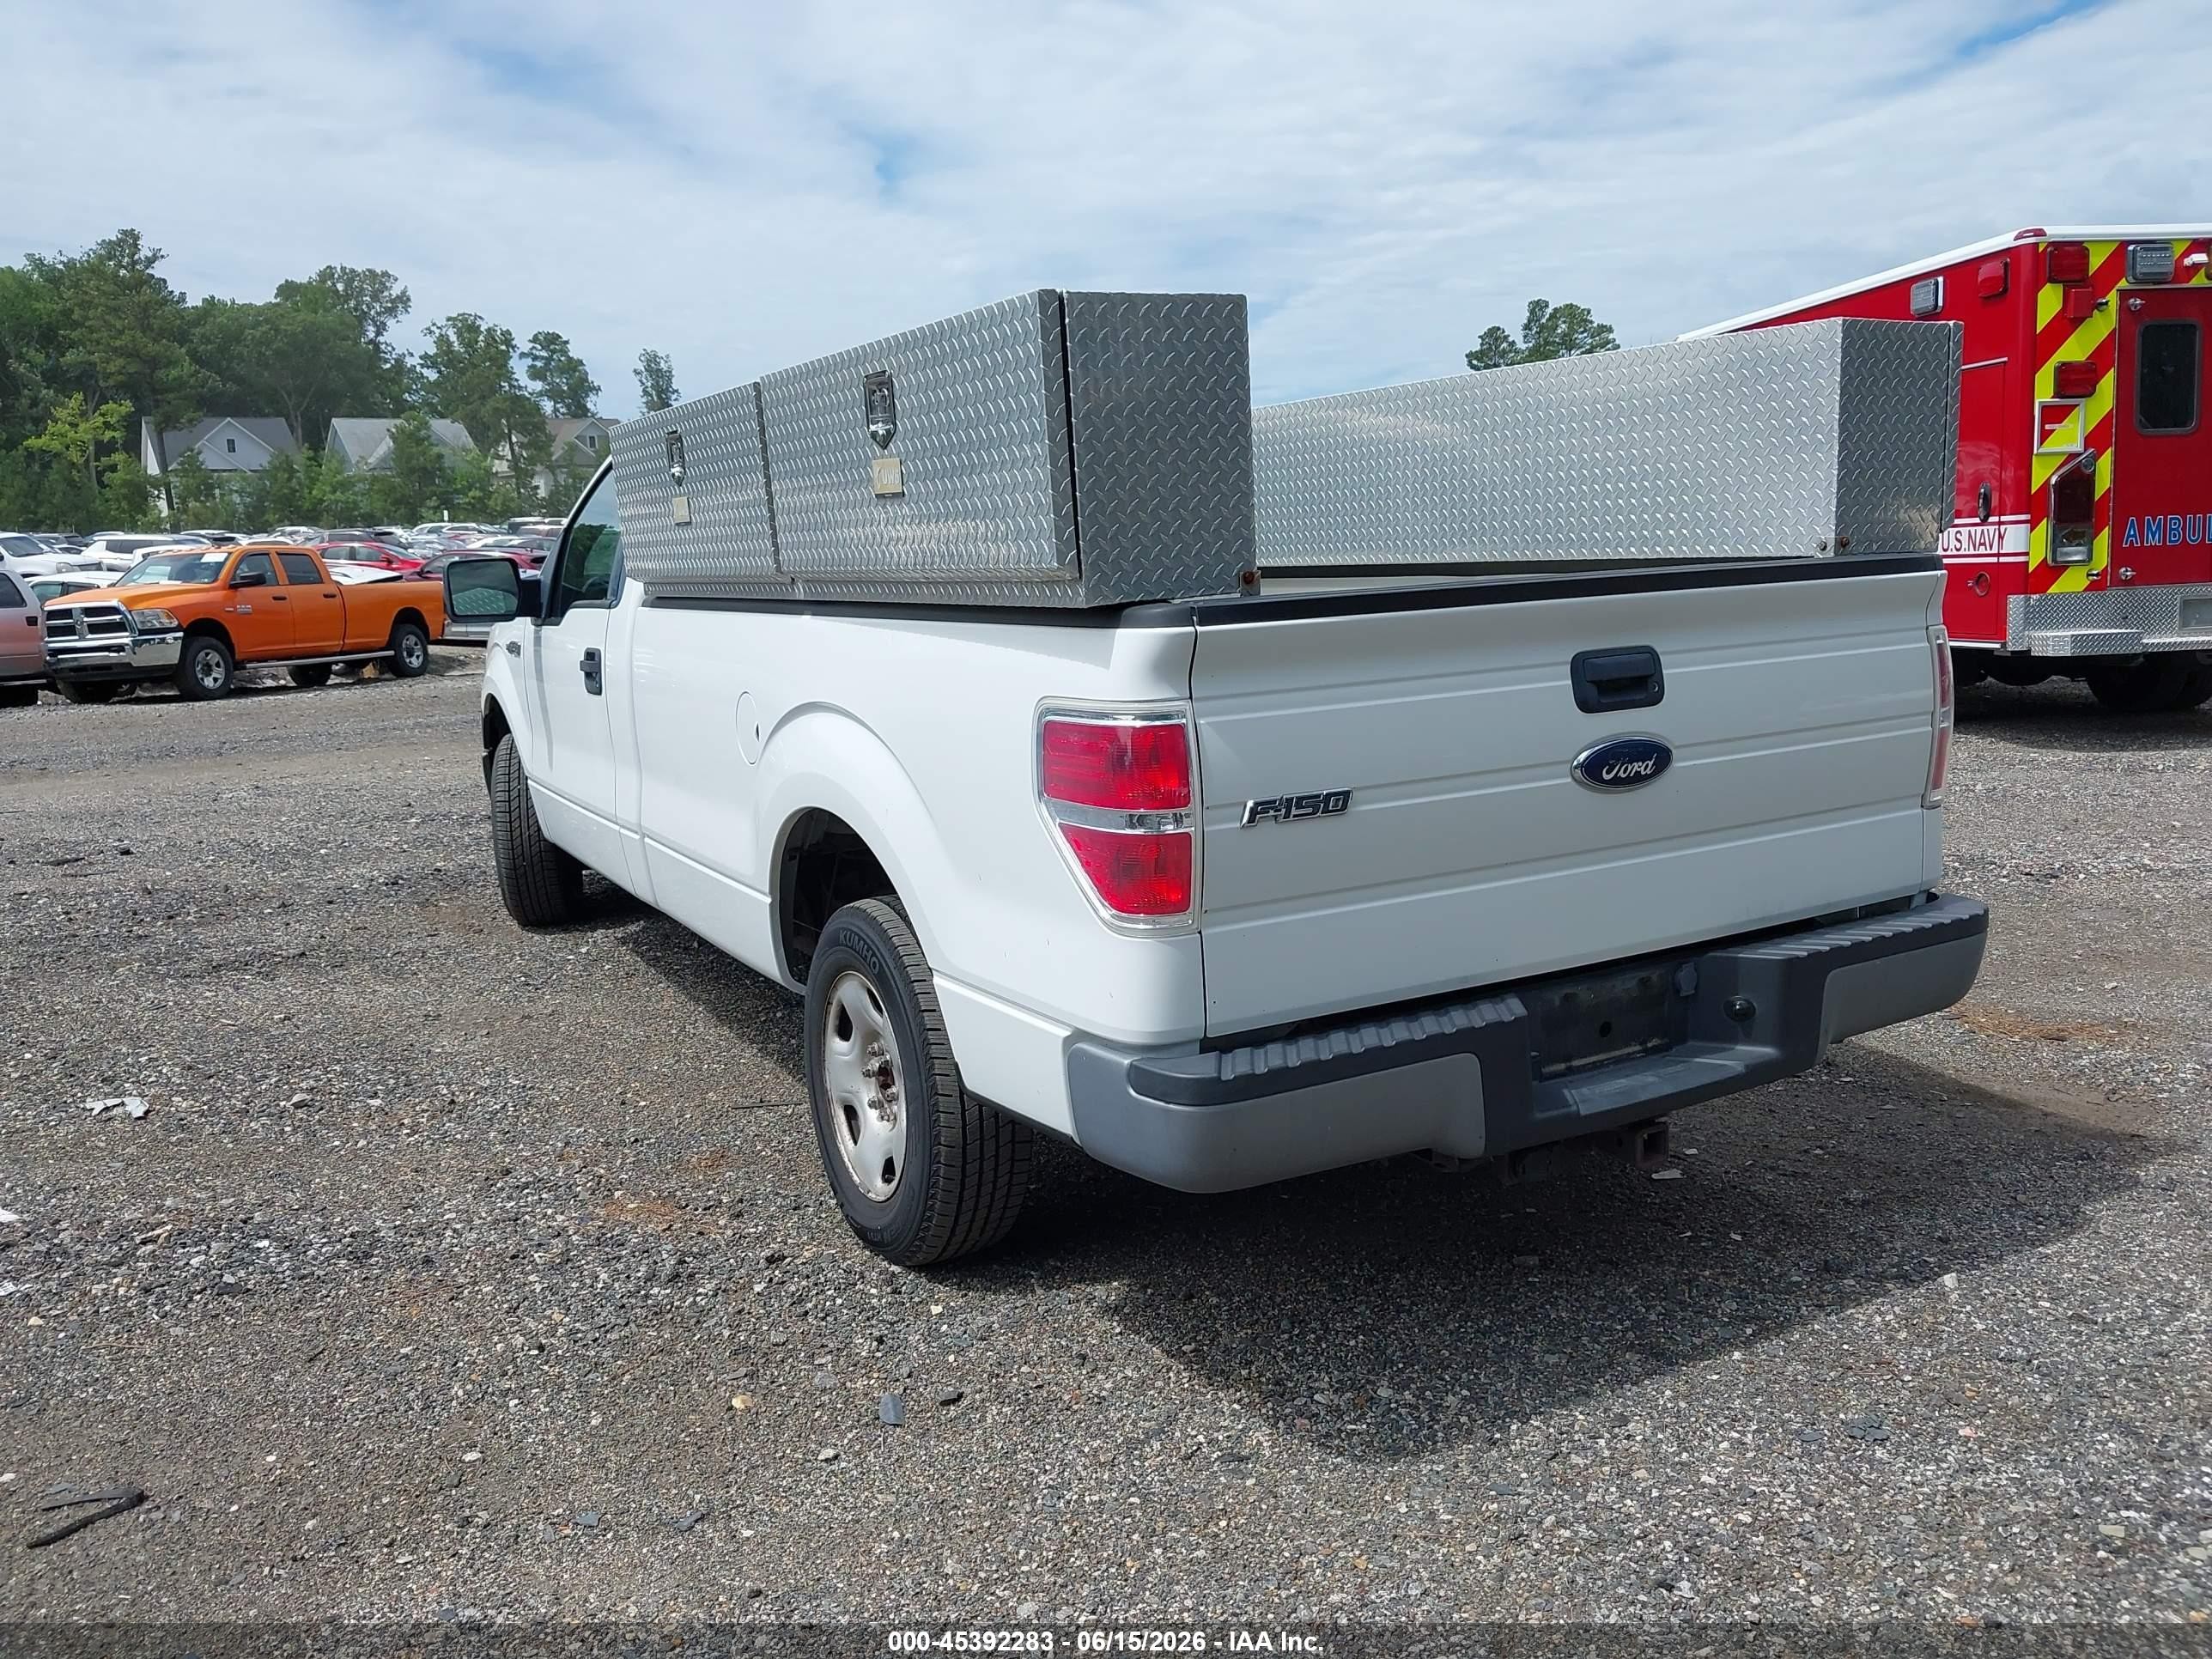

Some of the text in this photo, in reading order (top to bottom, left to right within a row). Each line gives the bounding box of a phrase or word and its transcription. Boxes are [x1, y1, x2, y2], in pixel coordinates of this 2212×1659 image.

[1602, 751, 1657, 781] Ford
[1240, 787, 1352, 829] F-150
[839, 929, 879, 975] KUMHO
